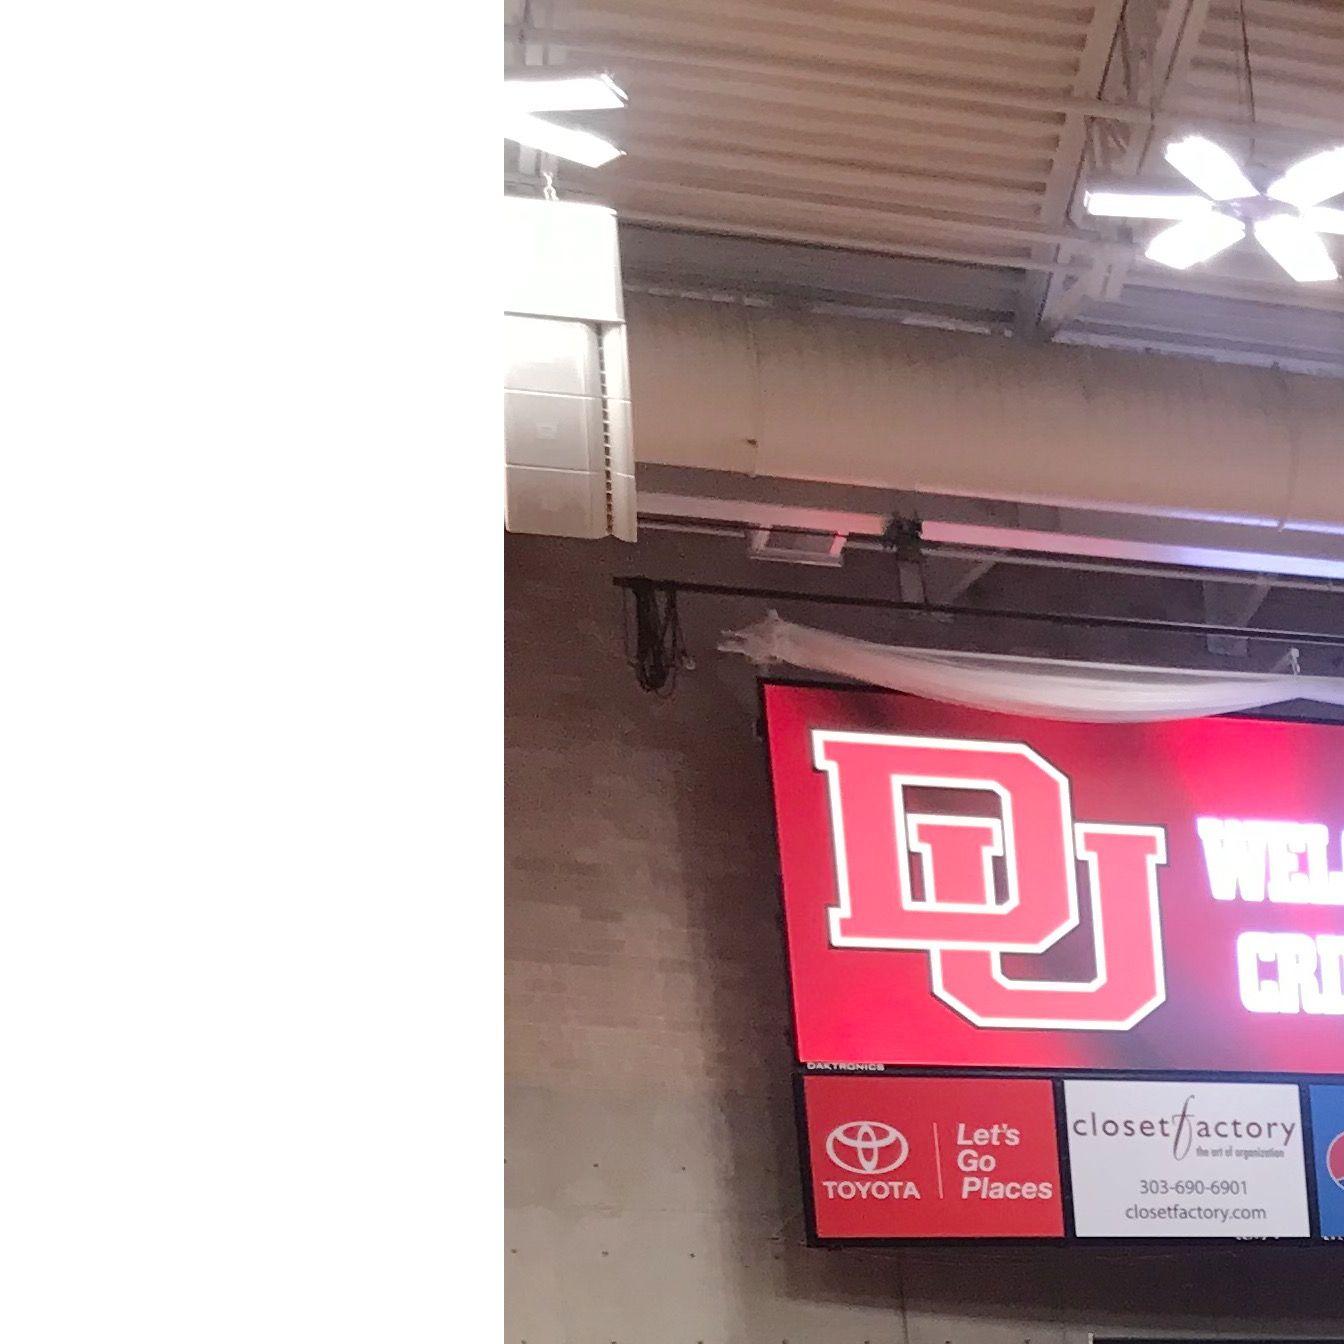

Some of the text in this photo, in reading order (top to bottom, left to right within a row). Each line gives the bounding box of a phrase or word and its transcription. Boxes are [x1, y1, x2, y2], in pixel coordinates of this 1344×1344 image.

[811, 728, 1168, 1031] DU
[806, 1061, 885, 1071] DAKTRONICS
[956, 1122, 1021, 1147] Let's
[957, 1149, 996, 1173] Go
[823, 1180, 921, 1200] TOYOTA
[961, 1176, 1053, 1200] Places
[1140, 1179, 1247, 1195] 303-690-6901
[1125, 1204, 1267, 1223] closetfactory.com
